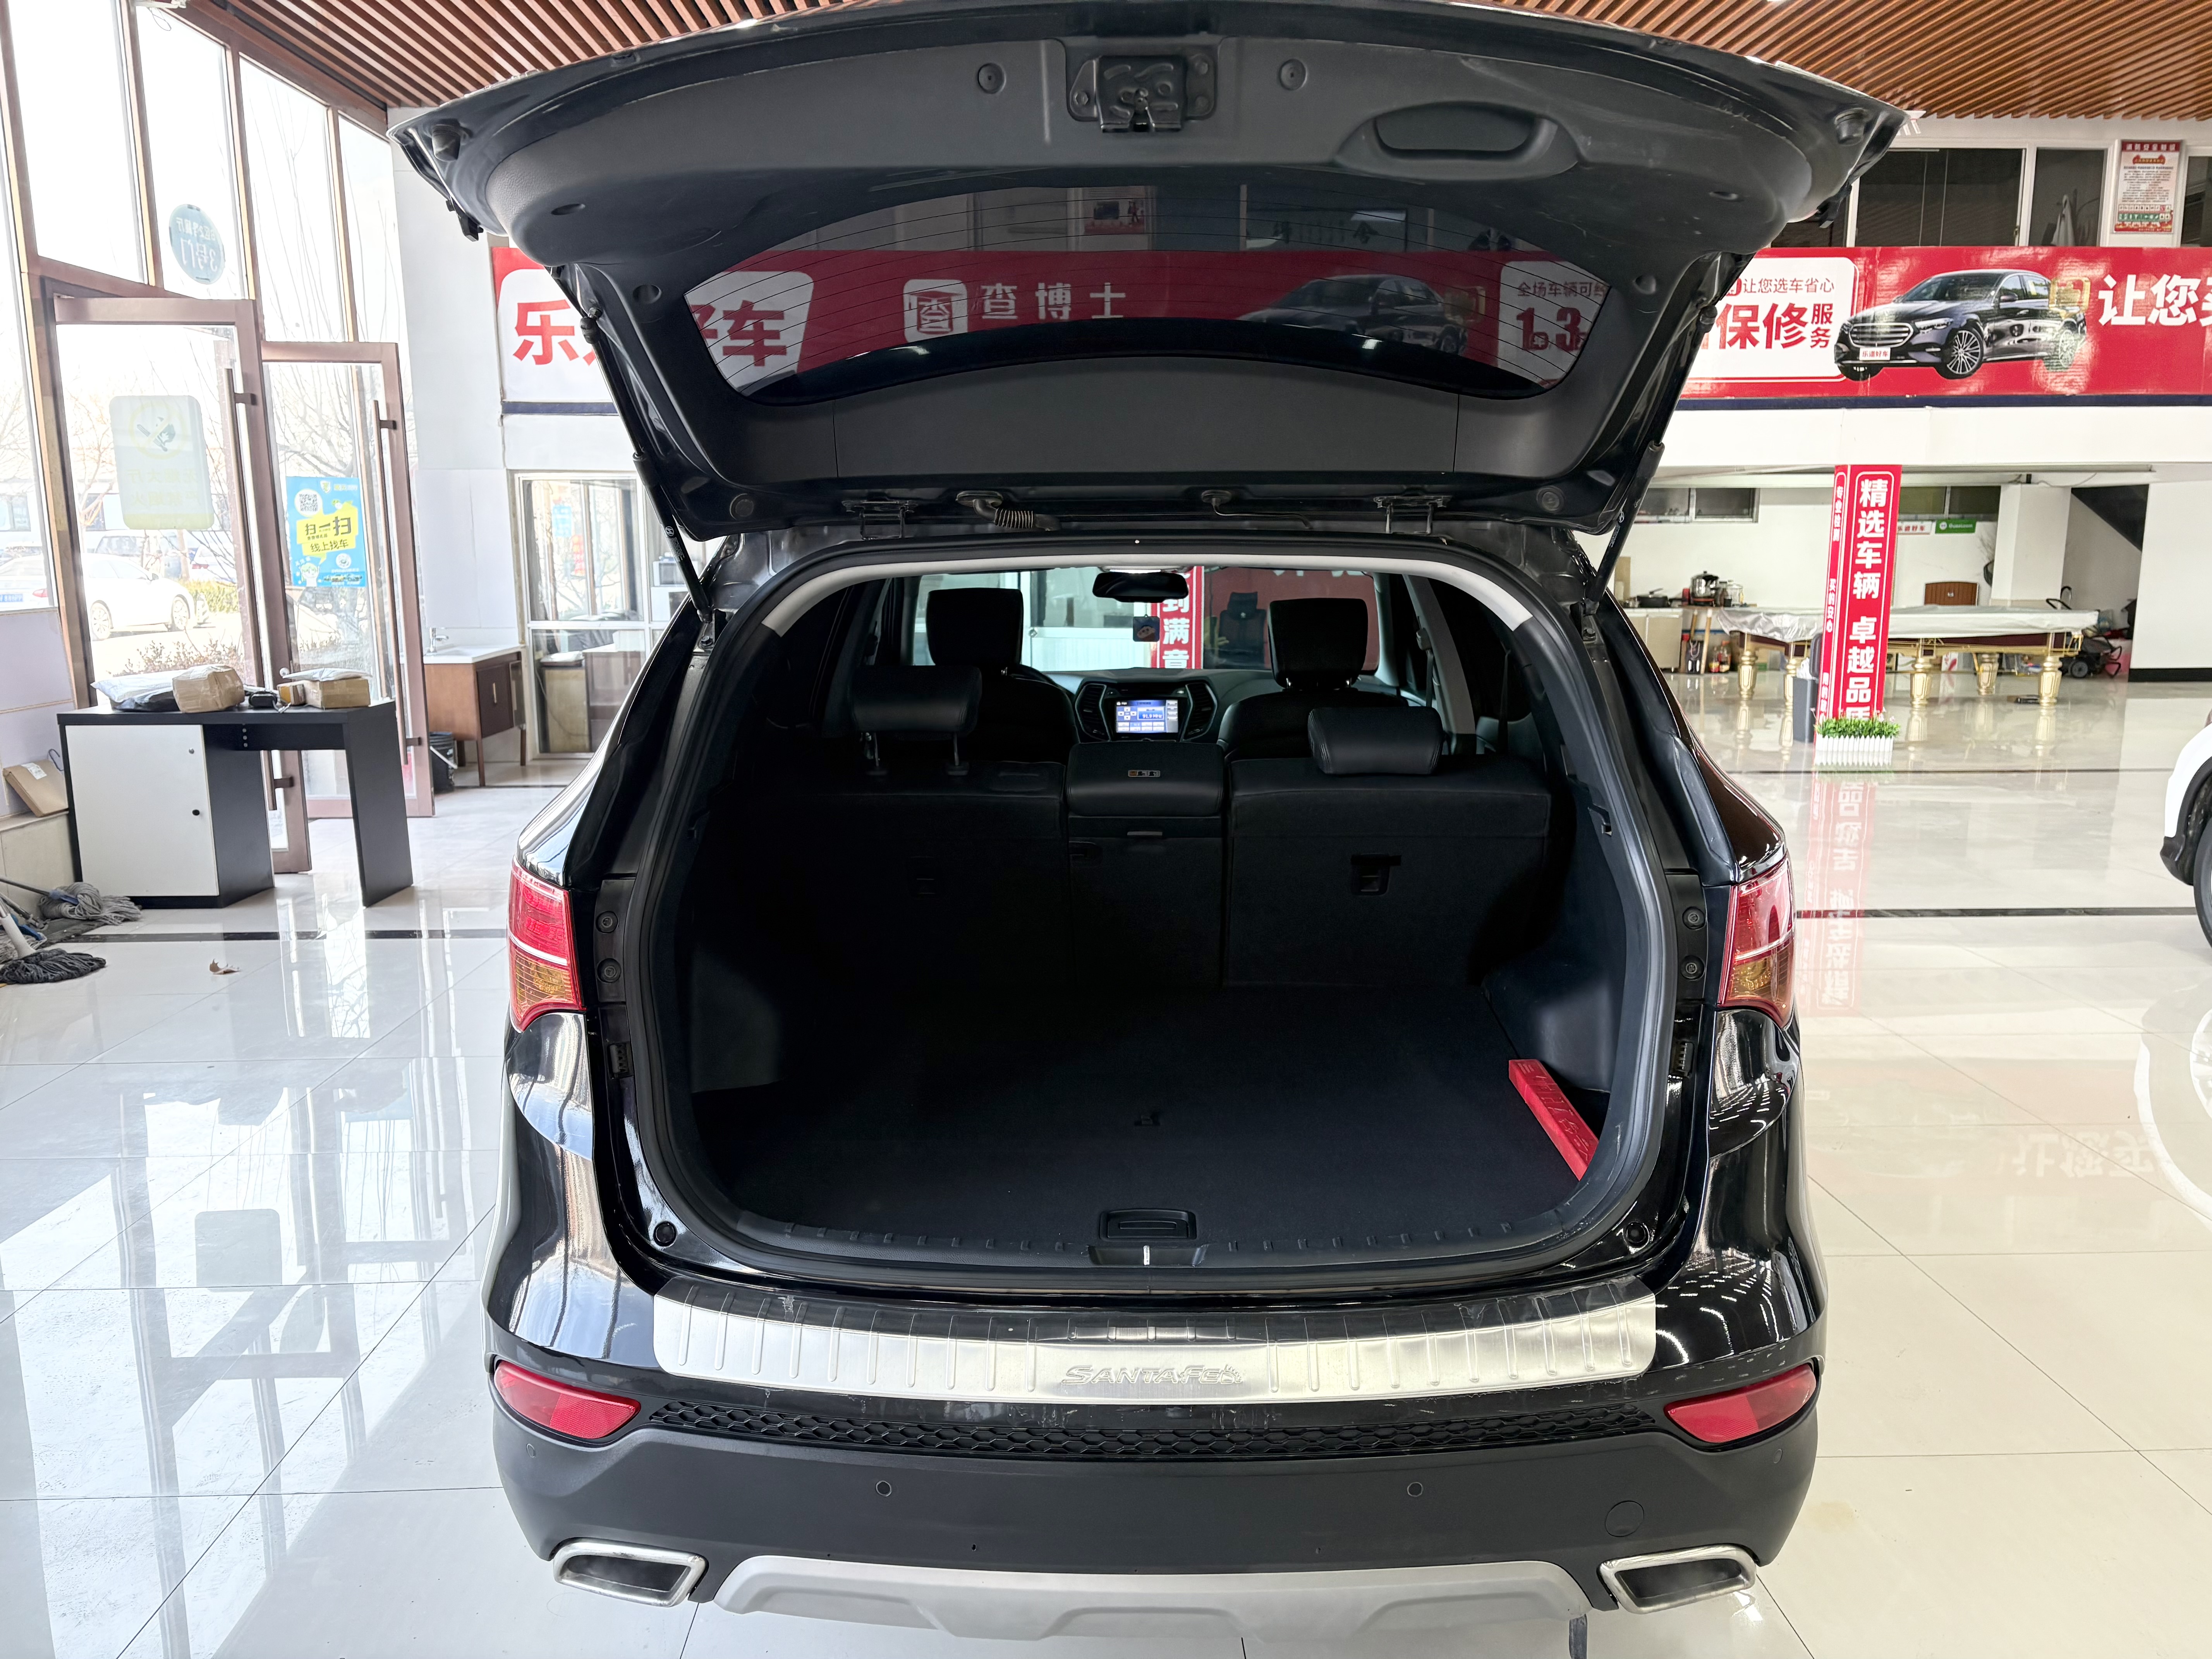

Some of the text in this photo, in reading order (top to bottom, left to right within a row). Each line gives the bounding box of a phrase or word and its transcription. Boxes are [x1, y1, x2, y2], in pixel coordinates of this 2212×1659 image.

[980, 282, 1126, 320] 查博士
[1743, 277, 1834, 294] 让您选车省心
[2098, 273, 2212, 327] 让您
[1700, 302, 1833, 350] 保修 服务
[305, 516, 352, 536] 扫一扫
[1852, 478, 1889, 600] 精选车辆
[310, 539, 349, 552] 线上找车
